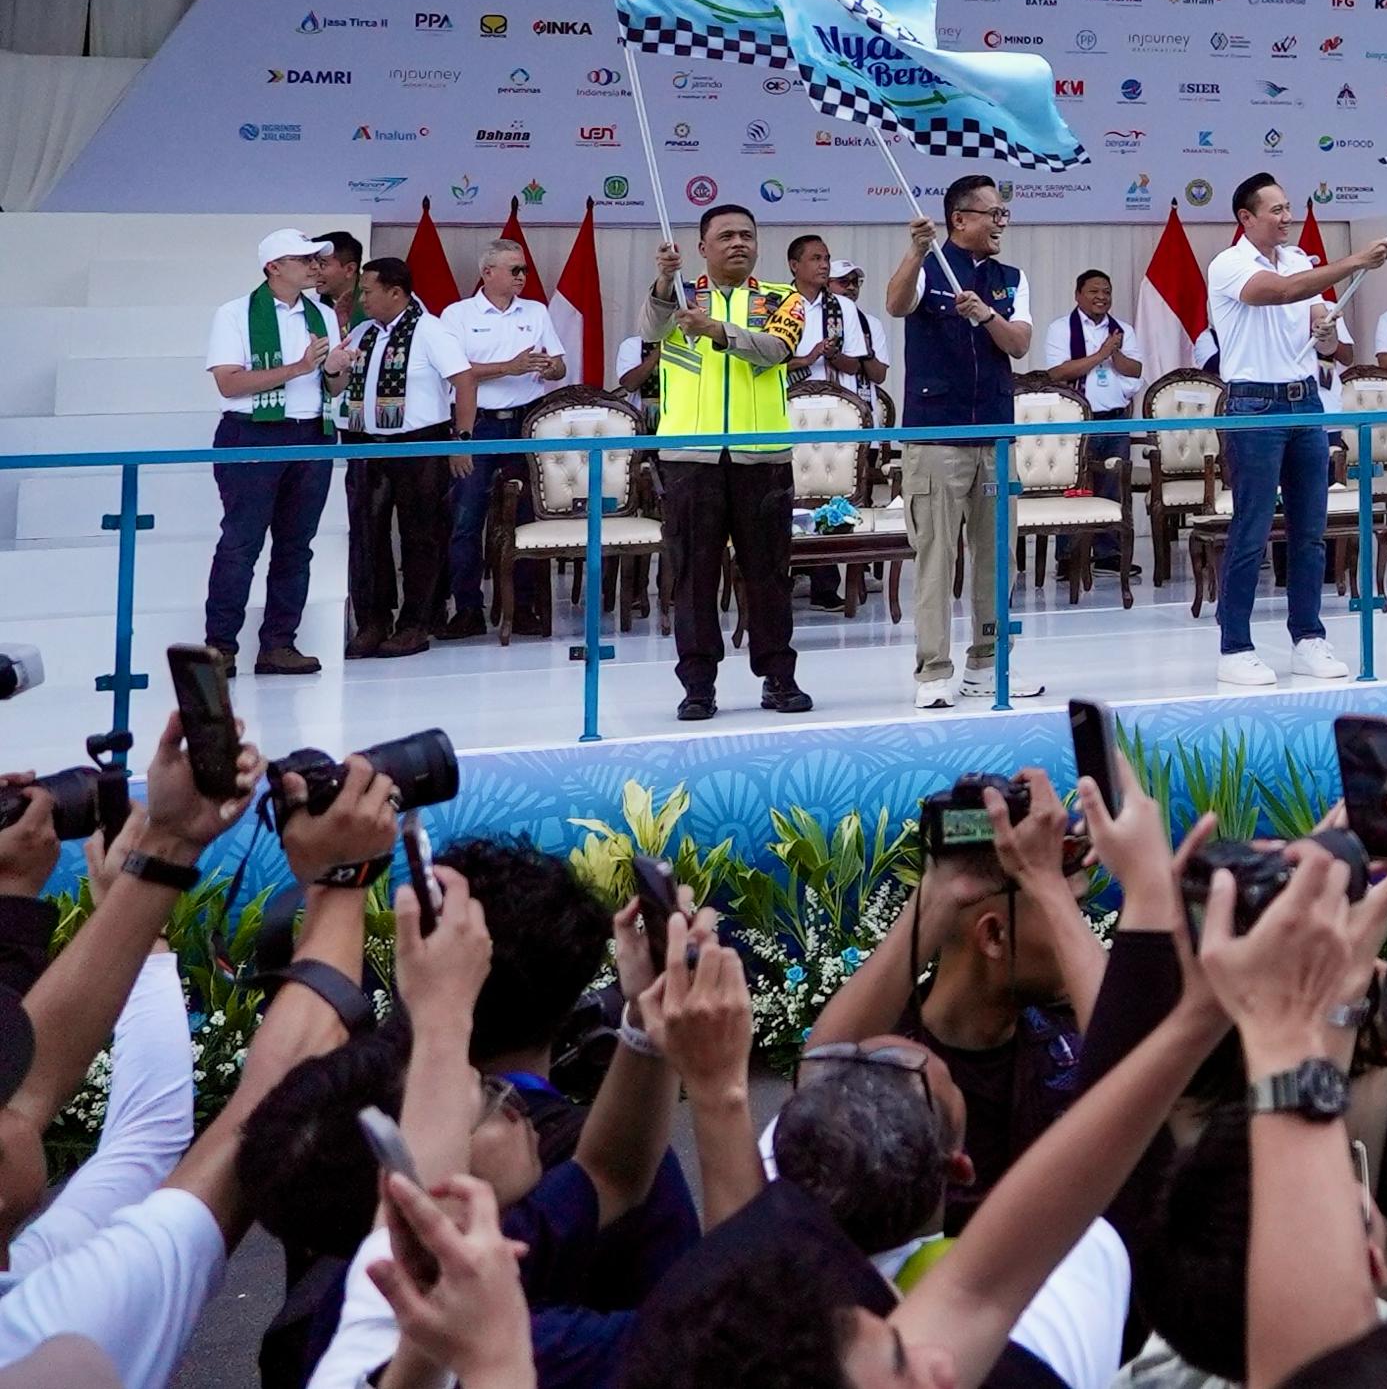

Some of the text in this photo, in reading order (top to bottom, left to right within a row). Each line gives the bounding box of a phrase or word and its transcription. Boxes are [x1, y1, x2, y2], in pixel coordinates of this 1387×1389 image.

[324, 17, 347, 28] Jasa
[415, 13, 453, 28] PPA
[547, 21, 592, 36] INKA
[1004, 36, 1043, 45] MIND ID
[287, 70, 352, 85] DAMRI
[390, 69, 462, 83] injourney
[577, 88, 619, 97] Indonesia
[1187, 84, 1220, 94] SIER
[375, 129, 417, 141] Inalum
[476, 129, 530, 141] Dahana
[835, 137, 861, 147] Bukit
[1336, 140, 1373, 148] ID FOOD
